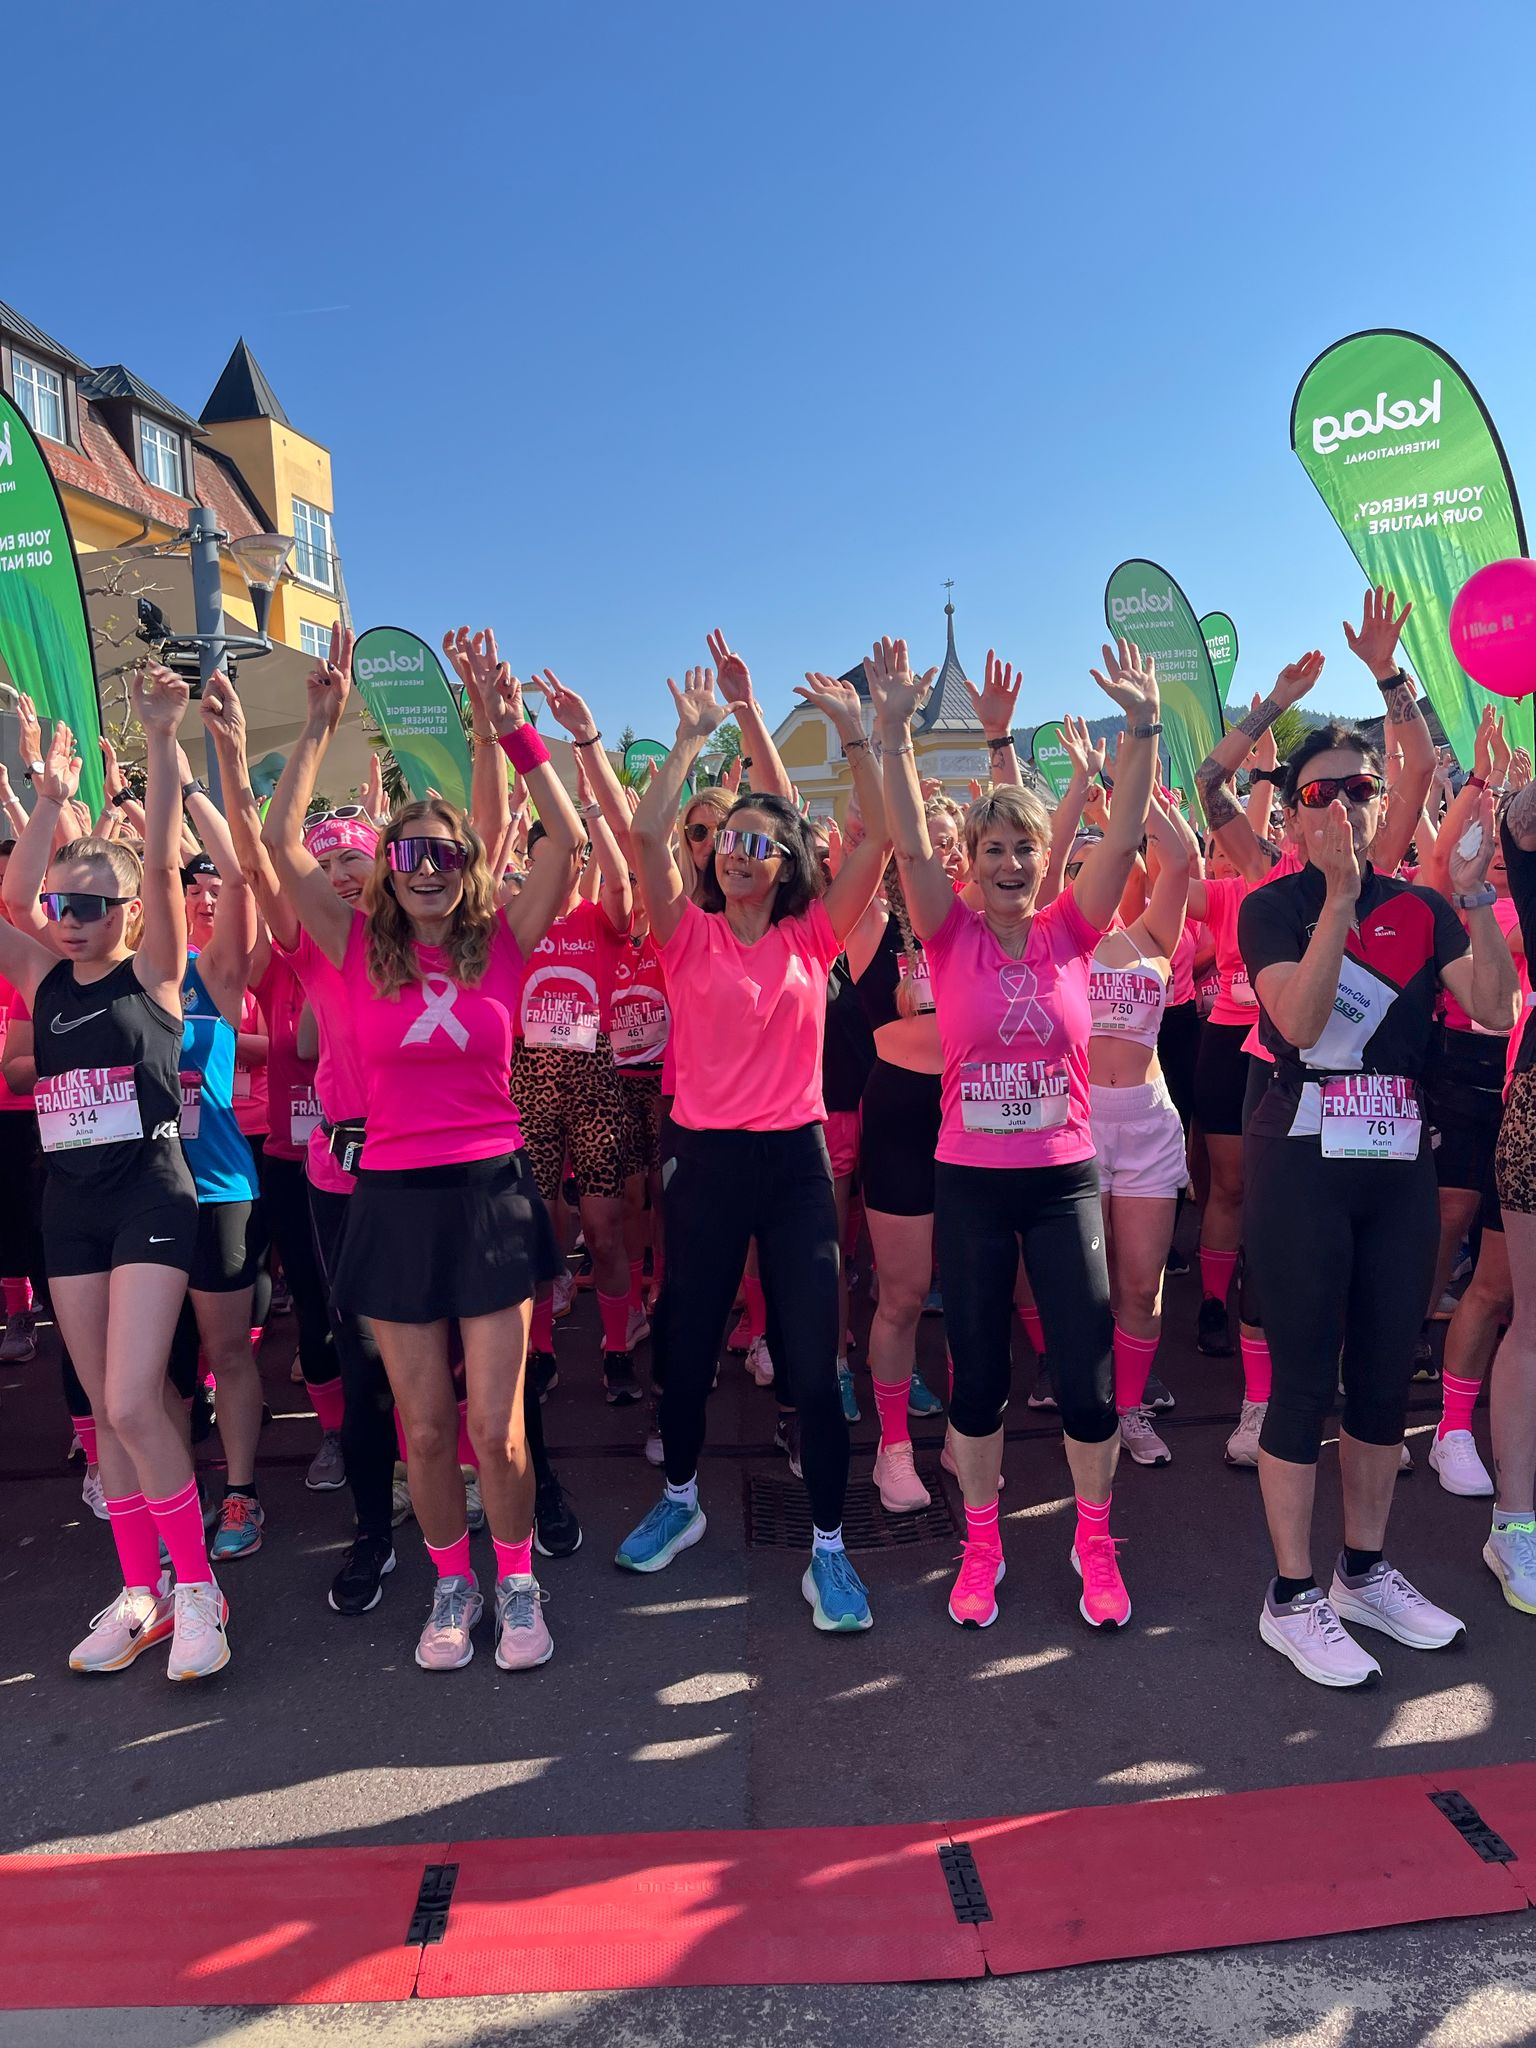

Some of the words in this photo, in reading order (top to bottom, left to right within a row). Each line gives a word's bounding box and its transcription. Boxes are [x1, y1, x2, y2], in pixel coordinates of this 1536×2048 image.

[1209, 647, 1231, 659] Netz
[313, 836, 338, 853] like
[340, 830, 352, 845] it
[1096, 974, 1100, 986] I
[1104, 973, 1132, 987] LIKE
[1136, 975, 1146, 989] IT
[541, 998, 546, 1011] I
[547, 998, 573, 1013] LIKE
[575, 1001, 586, 1014] IT
[614, 1007, 619, 1018] I
[619, 1003, 640, 1018] LIKE
[642, 1001, 651, 1013] IT
[1110, 1003, 1133, 1015] 750
[526, 1009, 598, 1028] FRAUENLAUF
[550, 1025, 571, 1036] 458
[627, 1027, 644, 1037] 461
[51, 1076, 56, 1092] I
[58, 1068, 91, 1091] LIKE
[95, 1067, 111, 1086] IT
[982, 1063, 987, 1082] I
[992, 1062, 1027, 1081] LIKE
[1032, 1060, 1046, 1080] IT
[961, 1076, 1069, 1101] FRAUENLAUF
[1345, 1076, 1351, 1096] I
[1356, 1076, 1393, 1097] LIKE
[1397, 1077, 1406, 1098] IT
[35, 1081, 135, 1114] FRAUENLAUF
[1001, 1103, 1032, 1117] 330
[1323, 1095, 1419, 1119] FRAUENLAUF
[68, 1109, 98, 1127] 314
[75, 1128, 94, 1136] Alina
[1366, 1120, 1395, 1136] 761
